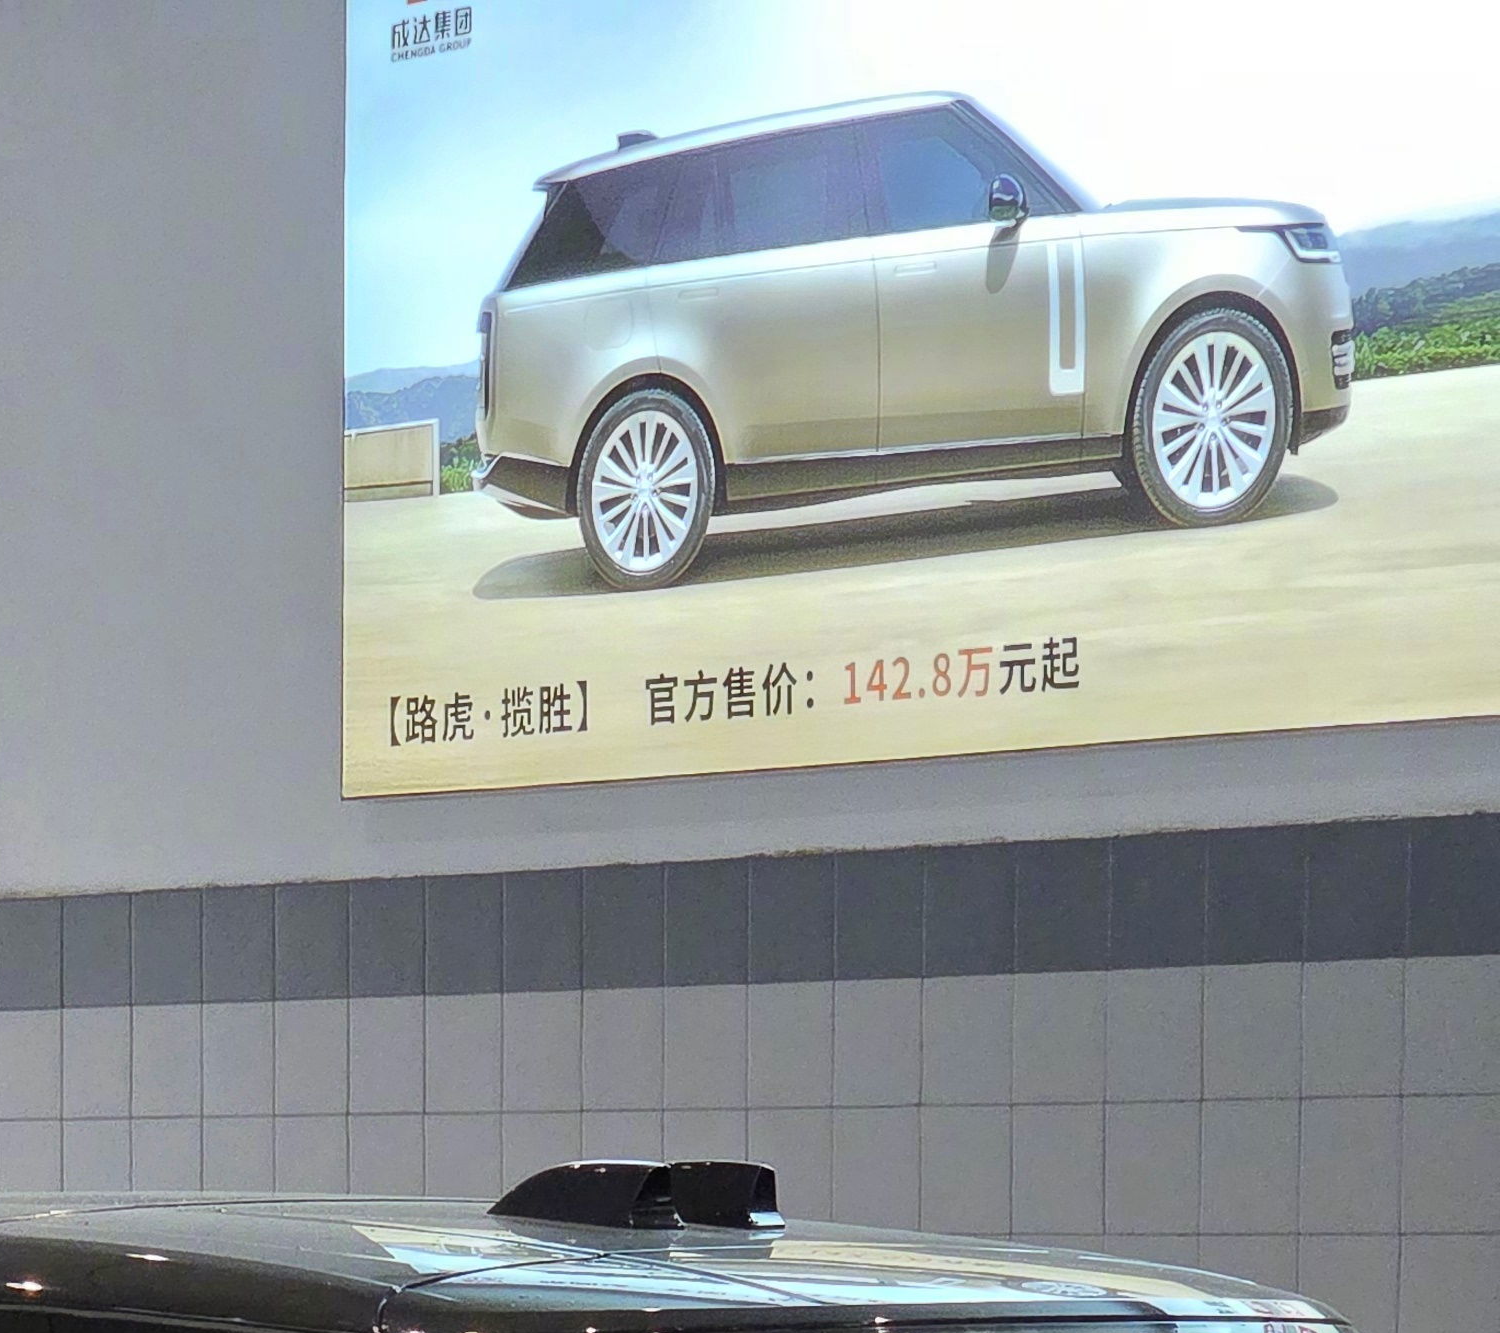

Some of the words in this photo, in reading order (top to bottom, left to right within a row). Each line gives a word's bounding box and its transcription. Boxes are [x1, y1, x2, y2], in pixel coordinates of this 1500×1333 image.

[392, 7, 472, 49] 成达集团
[391, 46, 436, 63] CHENGDA
[439, 37, 472, 53] GROUP
